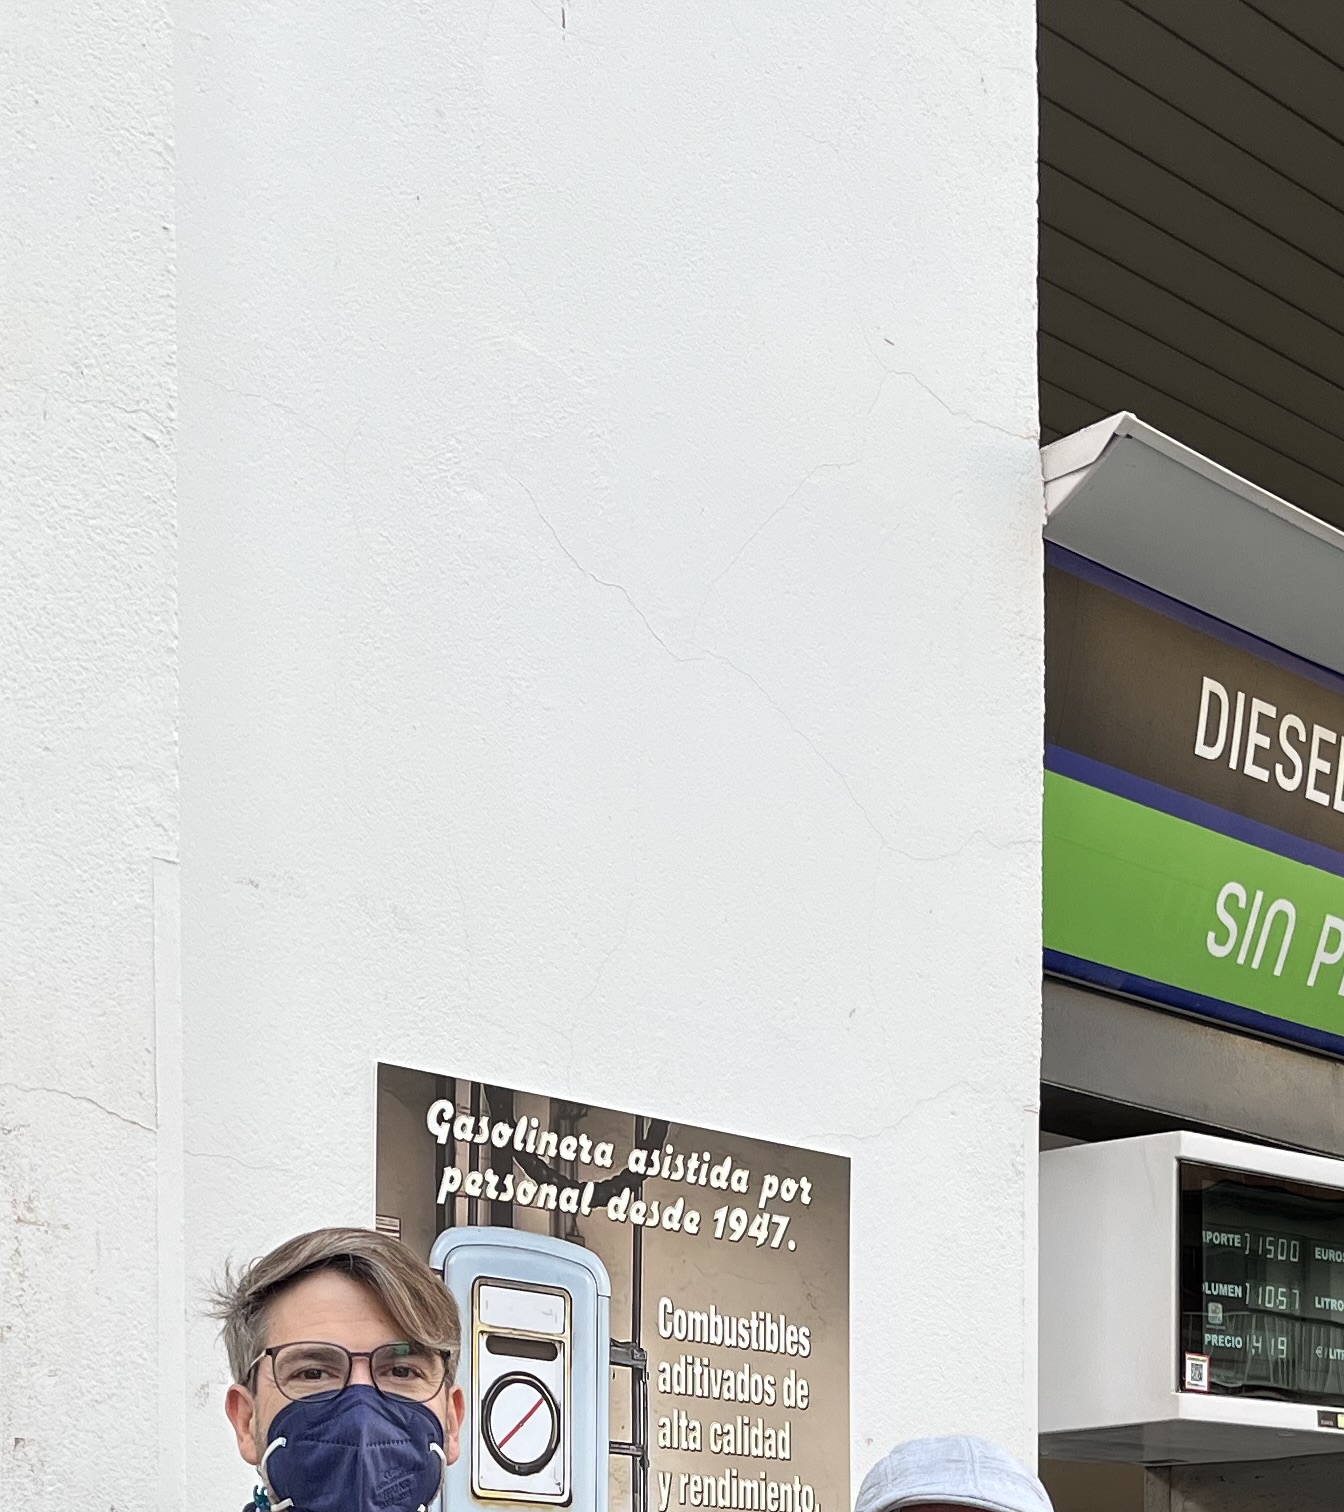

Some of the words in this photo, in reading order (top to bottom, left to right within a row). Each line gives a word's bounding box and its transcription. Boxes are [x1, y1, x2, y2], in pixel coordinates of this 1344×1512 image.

[1206, 881, 1297, 977] SIN
[426, 1098, 614, 1170] Gasolinera
[627, 1136, 750, 1193] asistida
[759, 1163, 813, 1208] por
[437, 1163, 593, 1217] personal
[607, 1193, 700, 1237] desde
[713, 1206, 797, 1251] 1947.
[1202, 1231, 1242, 1247] PORTE
[1202, 1282, 1242, 1298] LUMEN
[657, 1297, 812, 1358] Combustibles
[1204, 1333, 1243, 1349] PRECIO
[657, 1354, 776, 1407] aditivados
[782, 1371, 809, 1411] de
[657, 1417, 700, 1454] alta
[709, 1423, 791, 1461] calidad
[658, 1477, 672, 1512] y
